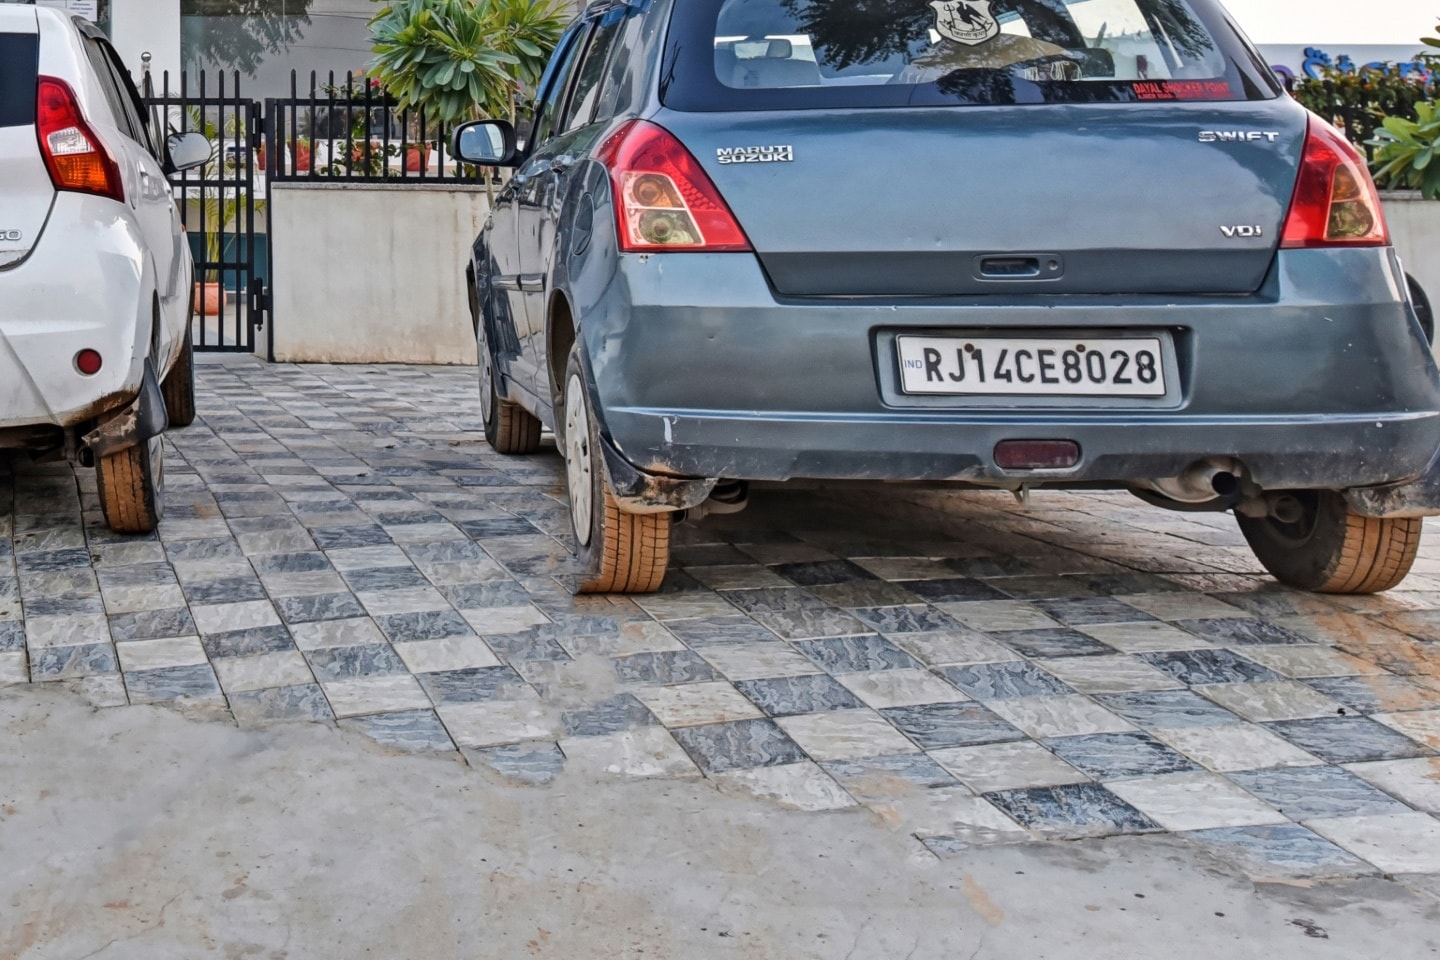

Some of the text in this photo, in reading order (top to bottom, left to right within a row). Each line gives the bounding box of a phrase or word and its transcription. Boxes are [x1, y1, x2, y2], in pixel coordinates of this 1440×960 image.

[1133, 82, 1162, 94] DAYAL
[1161, 81, 1203, 94] SHOCKER
[1198, 130, 1279, 143] SWIFT
[716, 145, 792, 156] MARUTI
[718, 152, 794, 164] SUZUKI
[904, 347, 1157, 384] IND RJ14CE8028
